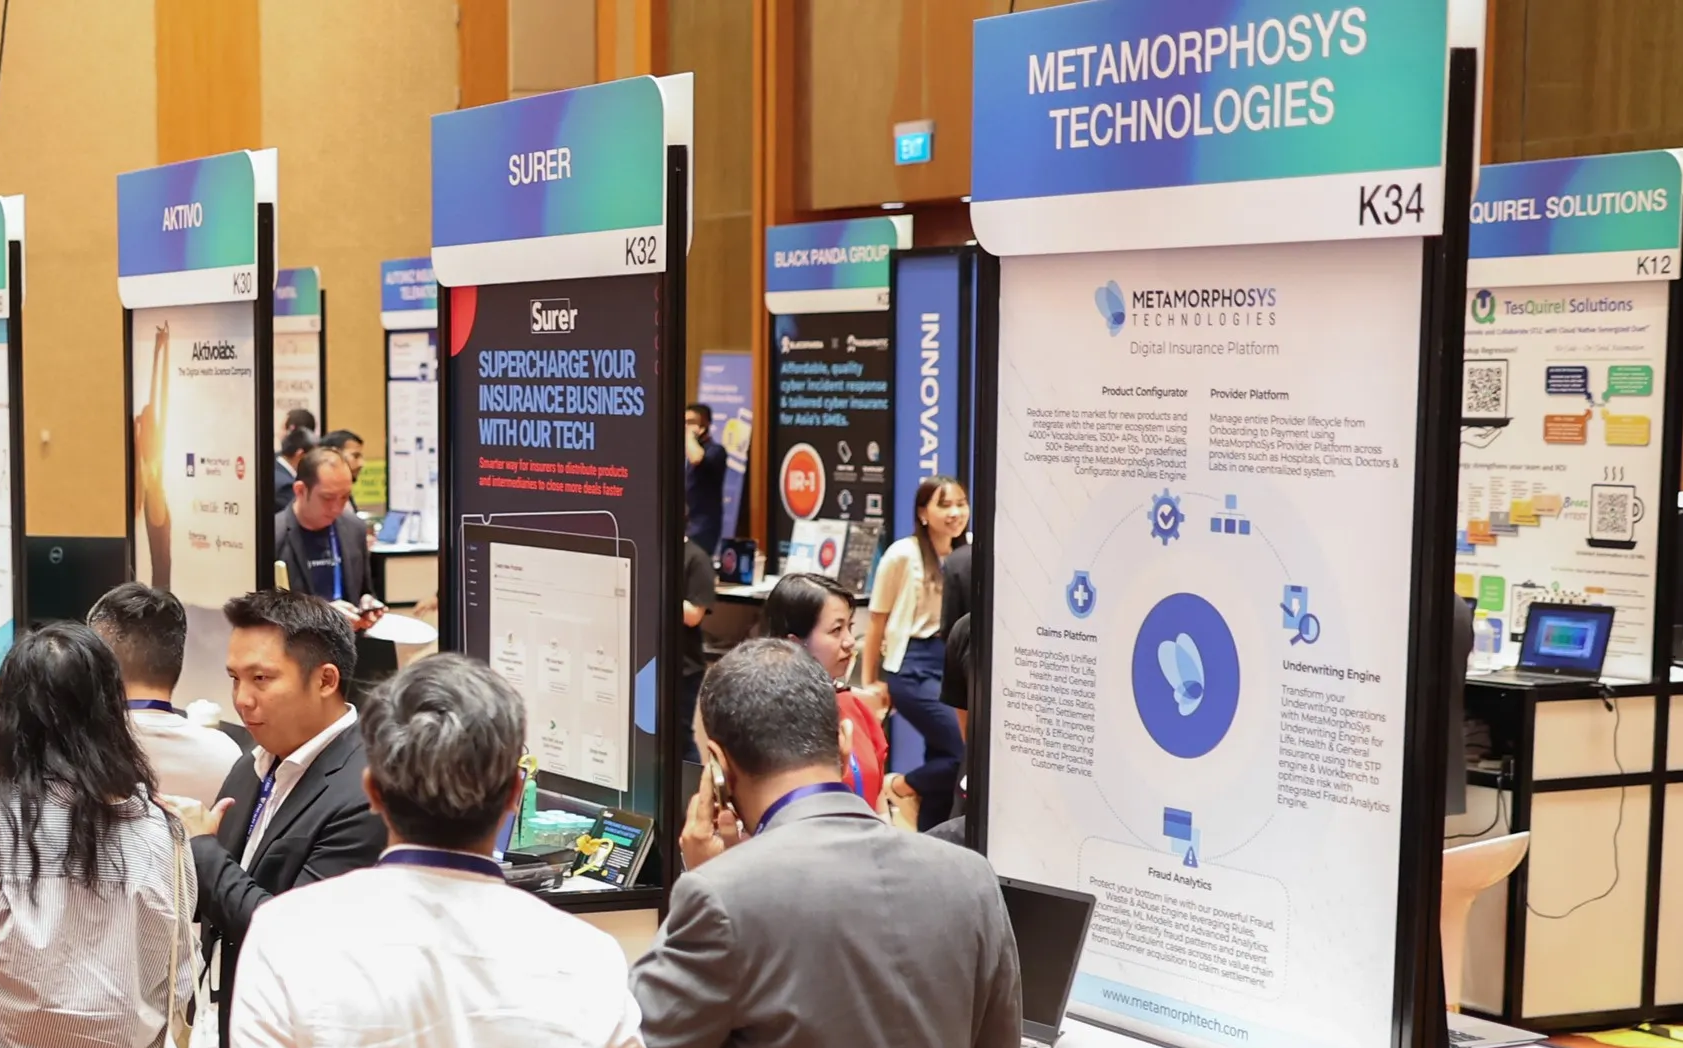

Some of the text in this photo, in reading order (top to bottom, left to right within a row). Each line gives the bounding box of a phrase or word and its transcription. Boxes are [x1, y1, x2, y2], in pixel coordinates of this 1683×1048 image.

[1028, 6, 1367, 95] METAMORPHOSYS
[1049, 78, 1334, 150] TECHNOLOGIES
[508, 147, 571, 187] SURER
[1358, 183, 1424, 227] K34
[1469, 188, 1668, 224] QUIREL SOLUTIONS
[162, 202, 203, 231] AKTIVO
[625, 236, 656, 267] K32
[775, 245, 890, 268] BLACK PANDA GROUP
[1637, 255, 1671, 275] K12
[233, 272, 252, 294] K30
[1132, 288, 1277, 309] METAMORPHOSYS
[1504, 297, 1633, 315] TesQuirel Solutions
[532, 302, 578, 331] Surer
[1132, 312, 1276, 326] TECHNOLOGIES
[192, 340, 237, 361] Aktivolabs.
[1130, 341, 1279, 357] Digital Insurance Platform
[479, 349, 636, 379] SUPERCHARGE YOUR
[479, 385, 645, 416] INSURANCE BUSINESS
[919, 313, 940, 483] INNOVAT
[1102, 386, 1187, 398] Product Configurator
[1211, 389, 1289, 400] Provider Platform
[1027, 409, 1052, 417] Reduce
[1054, 409, 1070, 418] time
[1071, 410, 1079, 418] to
[1080, 410, 1106, 418] market
[1107, 411, 1117, 419] for
[1136, 412, 1170, 422] products
[1210, 414, 1365, 428] Manage entire Provider lifecycle from
[479, 418, 595, 450] WITH OUR TECH
[1033, 420, 1186, 434] integrate with the partner ecosystem using
[1210, 426, 1334, 440] Onboarding to Payment using
[1029, 431, 1186, 445] 4000+ Vocabularies, 1500+ APIs, 1000+ Rules,
[1210, 438, 1382, 454] MetaMorphoSys Provider Platform across
[1024, 453, 1186, 468] Coverages using the MetaMorphoSys Product
[1046, 443, 1062, 451] 500+
[1063, 444, 1093, 453] Benefits
[1094, 445, 1108, 453] and
[1127, 446, 1143, 455] 150+
[1144, 447, 1186, 458] predefined
[1209, 451, 1246, 462] providers
[1247, 453, 1267, 461] such
[1280, 454, 1320, 466] Hospitals,
[1322, 456, 1352, 466] Clinics,
[1354, 457, 1390, 467] Doctors
[1391, 459, 1398, 468] &
[479, 457, 628, 479] Smarter way for insurers to distribute products
[1075, 466, 1186, 481] Configurator and Rules Engine
[1209, 463, 1227, 471] Labs
[1229, 464, 1236, 472] in
[1255, 465, 1301, 475] centralized
[1303, 467, 1335, 478] system.
[479, 476, 624, 496] and intermediaries to close more deals faster
[1036, 626, 1097, 643] Claims Platform
[1283, 660, 1381, 683] Underwriting Engine
[1148, 867, 1212, 891] Fraud Analytics
[1102, 987, 1249, 1041] www.metamorphtech.com
